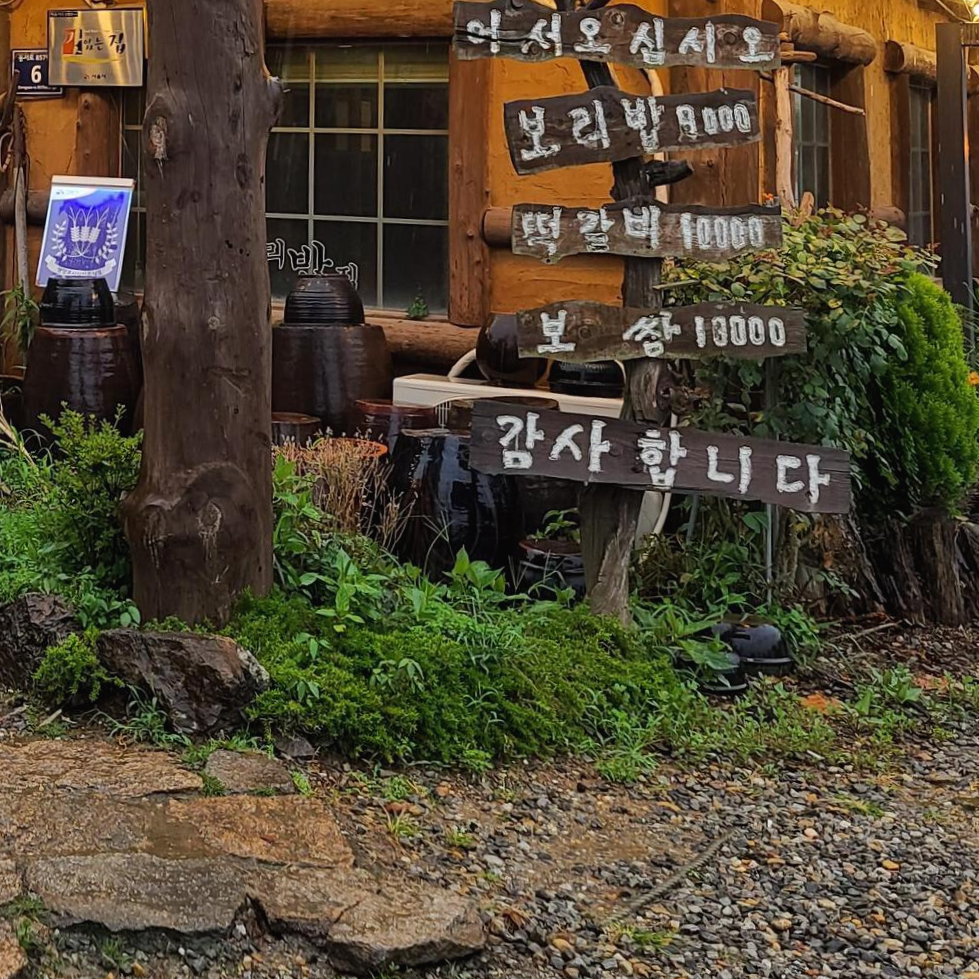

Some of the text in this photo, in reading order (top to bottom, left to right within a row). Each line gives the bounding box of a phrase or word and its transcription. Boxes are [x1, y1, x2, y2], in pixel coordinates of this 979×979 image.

[466, 8, 774, 65] 어서오십시오
[31, 65, 42, 83] 6
[520, 96, 664, 160] 보리밥
[522, 204, 764, 256] 떡갈비 10000
[497, 411, 830, 504] 감사합니다
